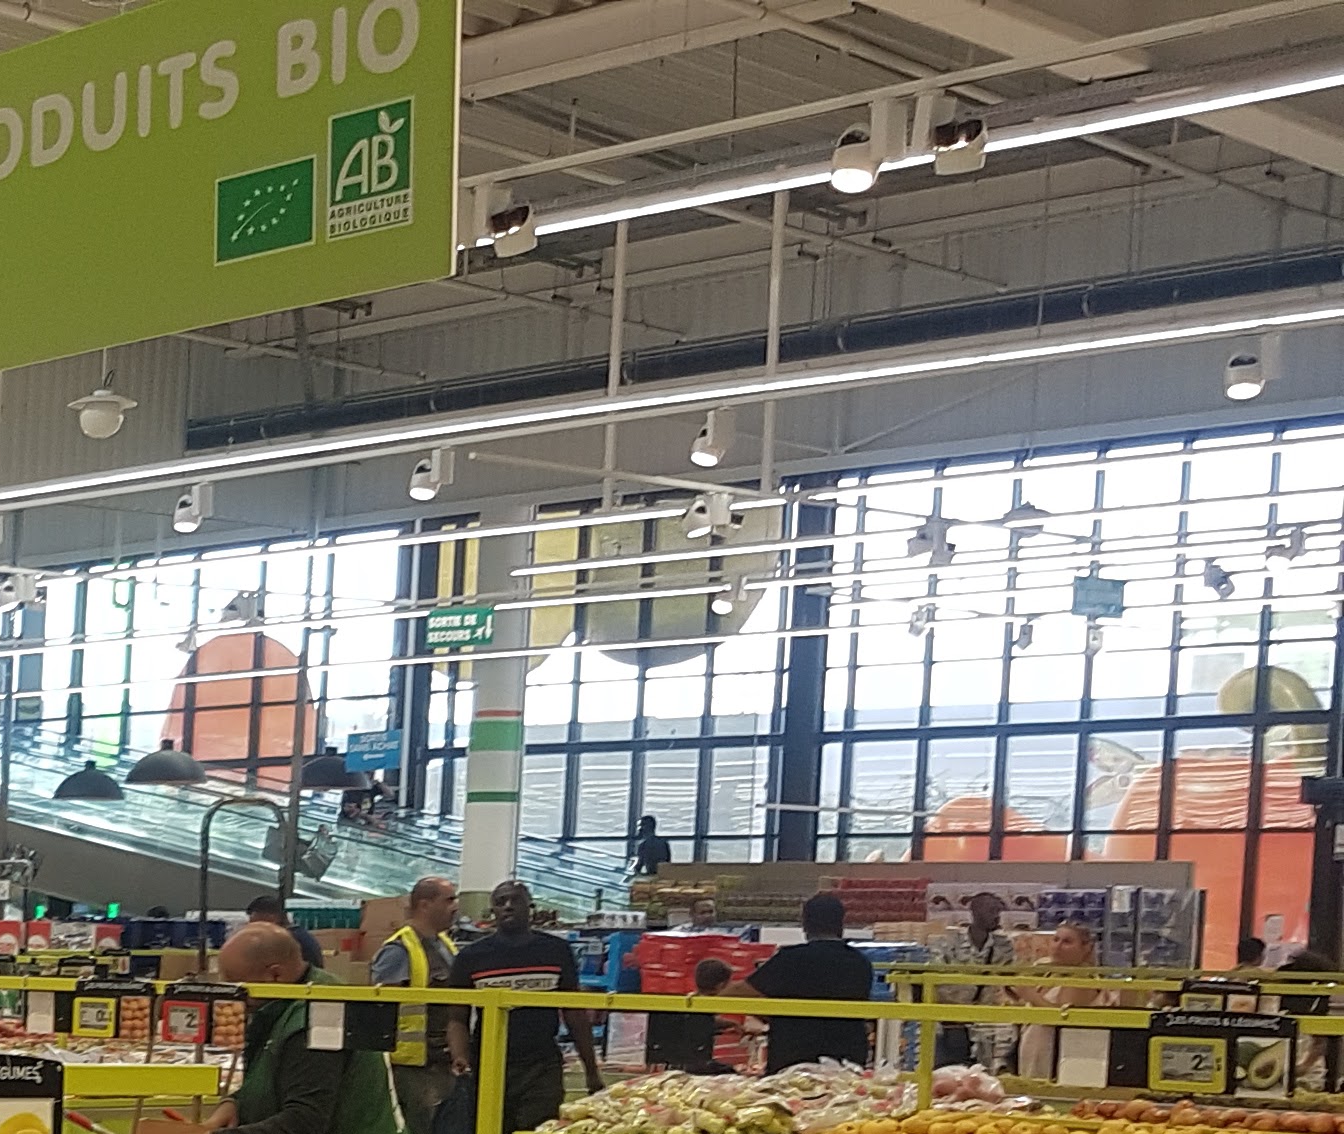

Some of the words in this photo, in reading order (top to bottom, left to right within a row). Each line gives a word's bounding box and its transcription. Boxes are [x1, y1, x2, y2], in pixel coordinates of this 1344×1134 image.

[276, 0, 420, 98] BIO
[335, 133, 400, 200] AB
[328, 192, 411, 221] AGRICULTURE
[328, 207, 410, 236] BIOLOGIQUE
[427, 629, 471, 643] SECOURS
[428, 615, 462, 629] SORTIE
[464, 614, 477, 626] DE
